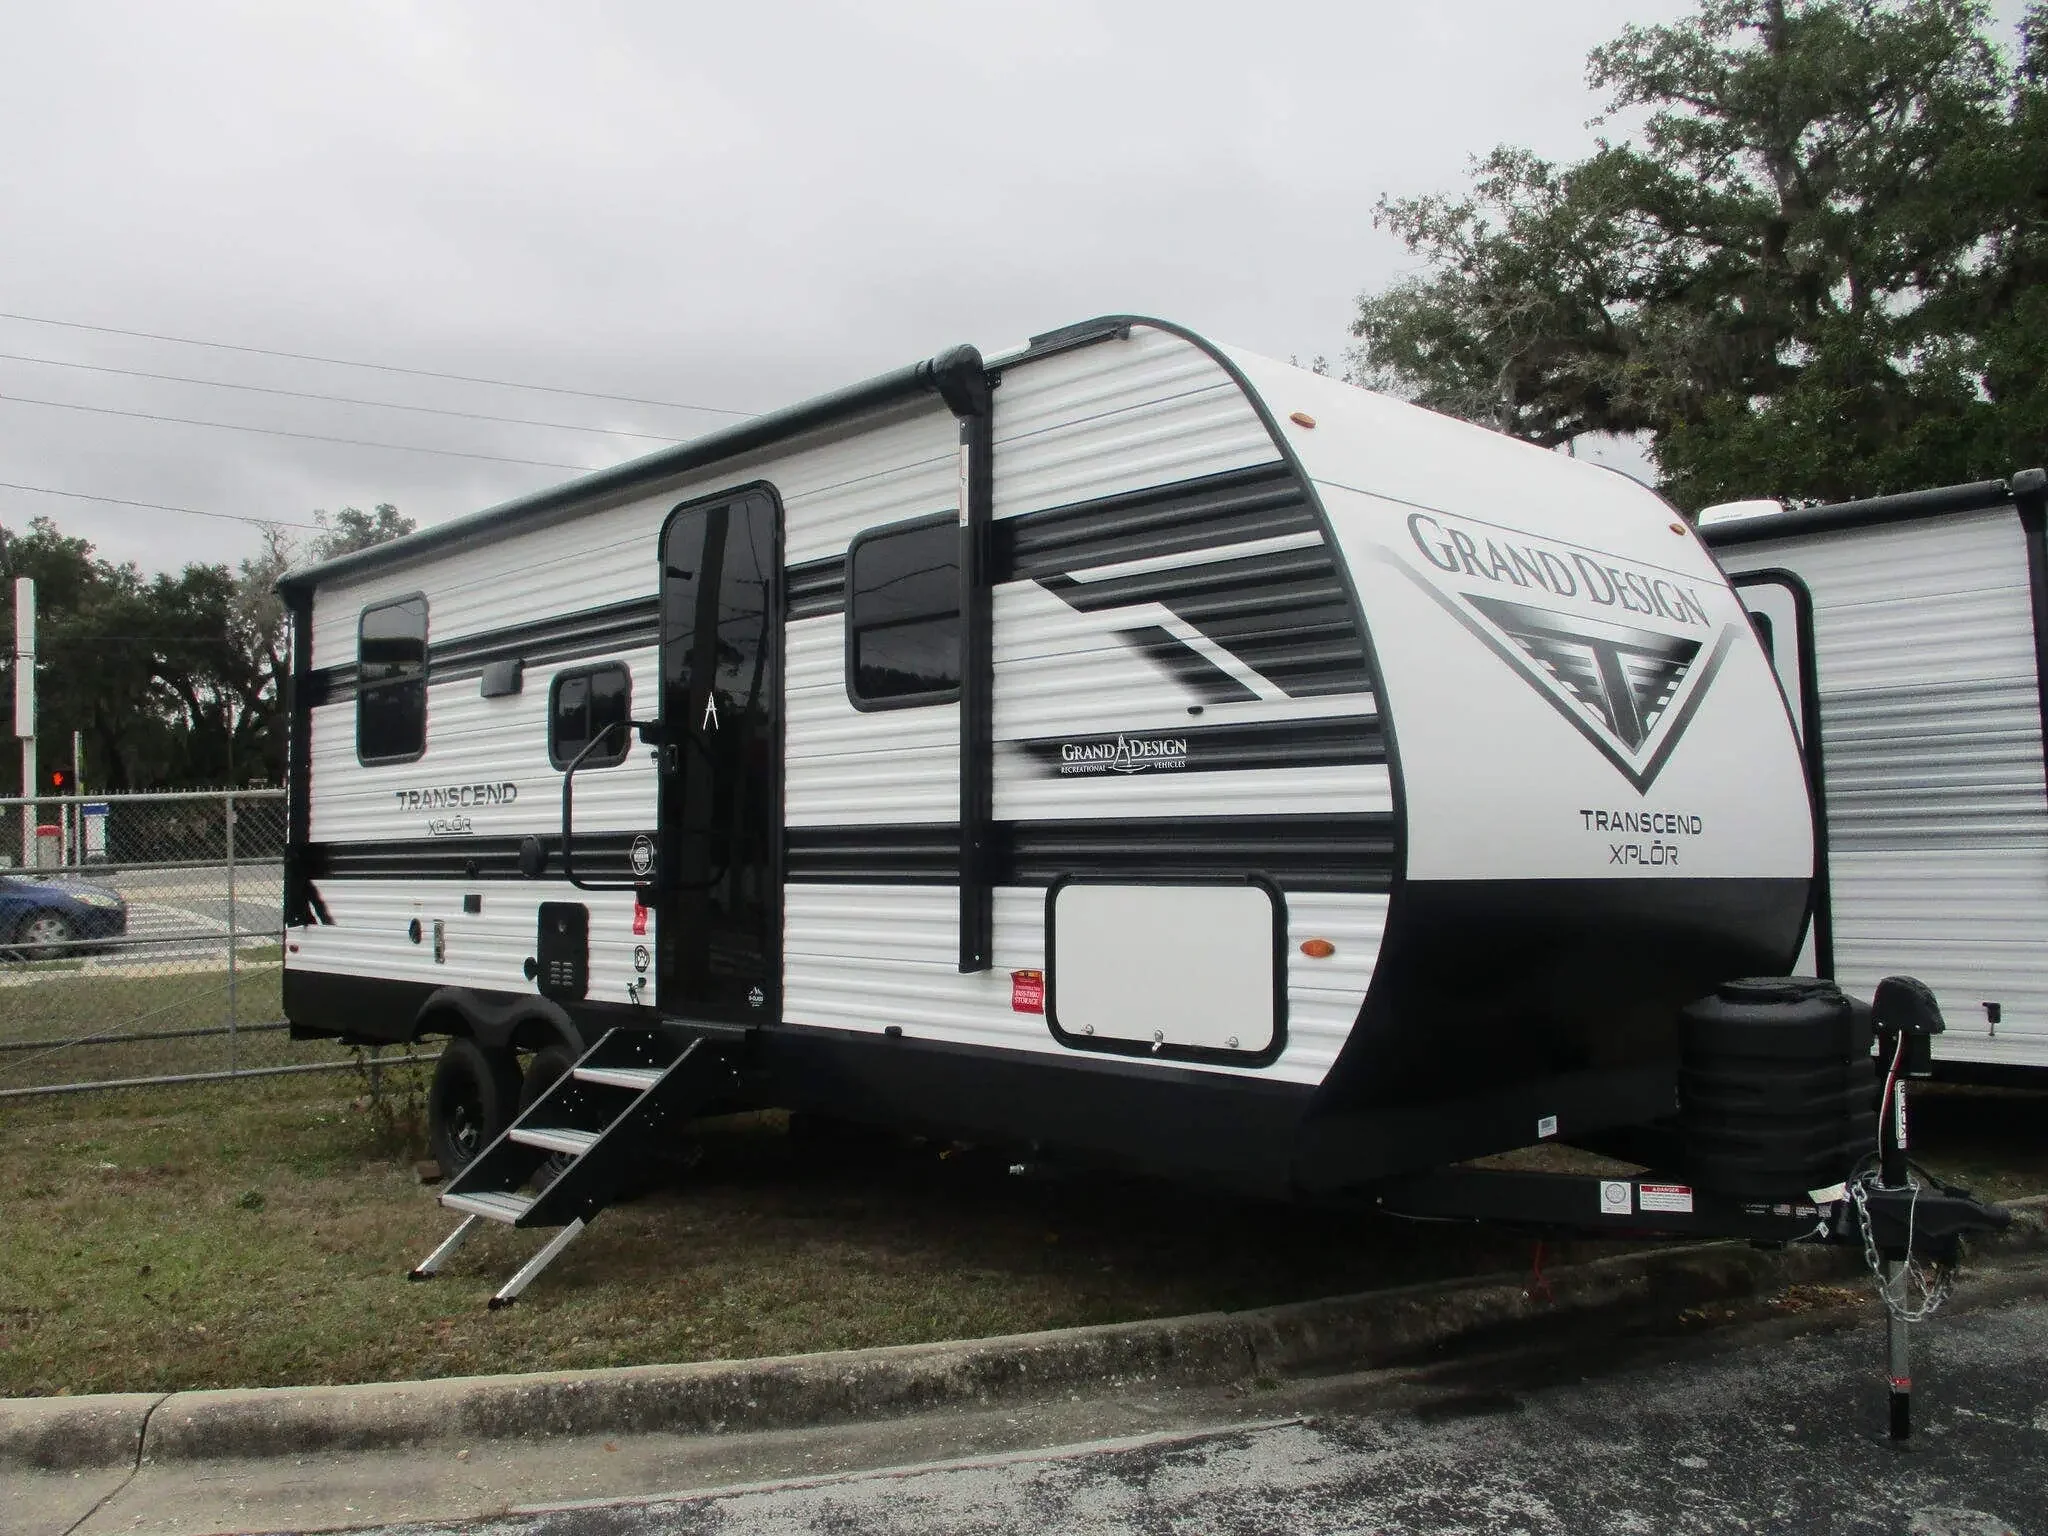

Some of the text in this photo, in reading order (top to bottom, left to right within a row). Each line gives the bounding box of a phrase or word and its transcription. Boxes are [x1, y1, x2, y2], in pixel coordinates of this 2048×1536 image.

[1406, 513, 1712, 629] GRAND DESIGN
[1060, 738, 1188, 761] GRAND DESIGN
[1059, 759, 1187, 774] RECREATIONAL VEHICLES
[395, 782, 518, 812] TRANSCEND
[1579, 809, 1703, 835] TRANSCEND
